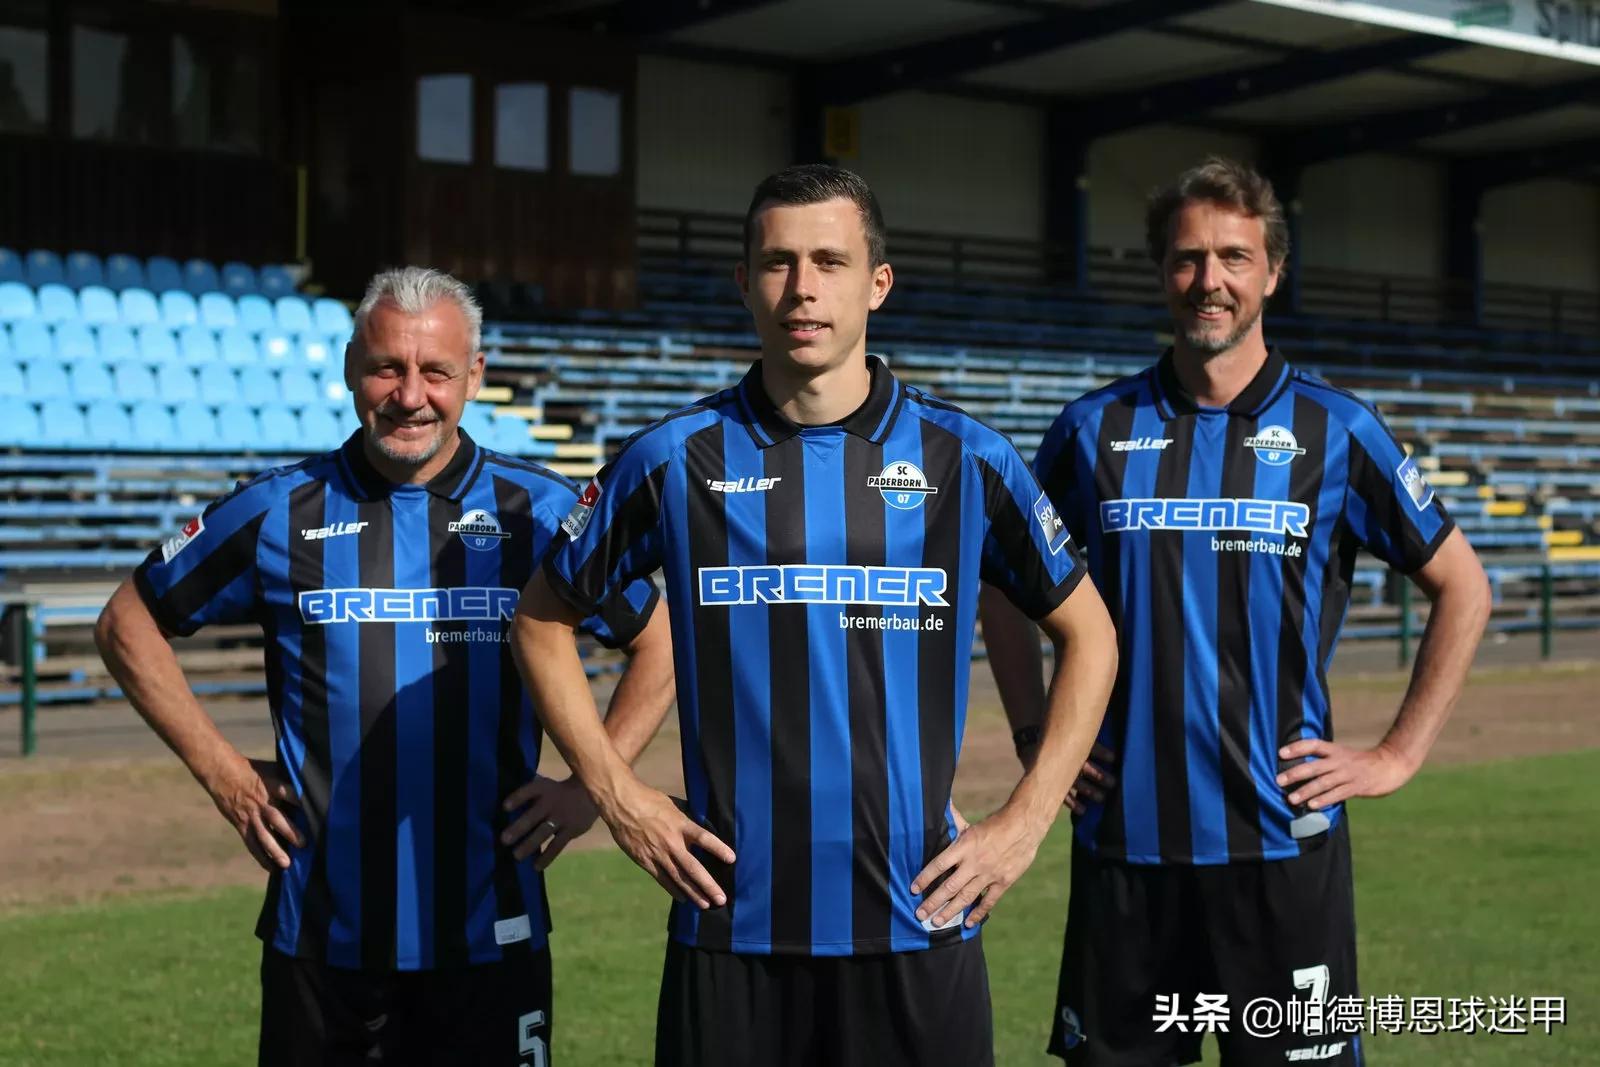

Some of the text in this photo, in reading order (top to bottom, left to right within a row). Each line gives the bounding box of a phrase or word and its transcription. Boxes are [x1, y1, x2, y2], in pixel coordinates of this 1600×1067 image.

[1268, 452, 1281, 461] 07
[897, 466, 908, 475] SC
[868, 477, 922, 487] PADERBORN
[897, 494, 911, 504] 07
[475, 514, 485, 522] SC
[1040, 502, 1053, 525] sky
[1100, 498, 1310, 538] BREMER
[449, 523, 497, 532] PADERBORN
[475, 538, 487, 546] 07
[1211, 537, 1303, 558] bremerbau.de
[698, 564, 950, 606] BREMER
[839, 612, 944, 631] bremerbau.de
[425, 628, 511, 643] bremerbau.
[518, 1010, 547, 1067] 5
